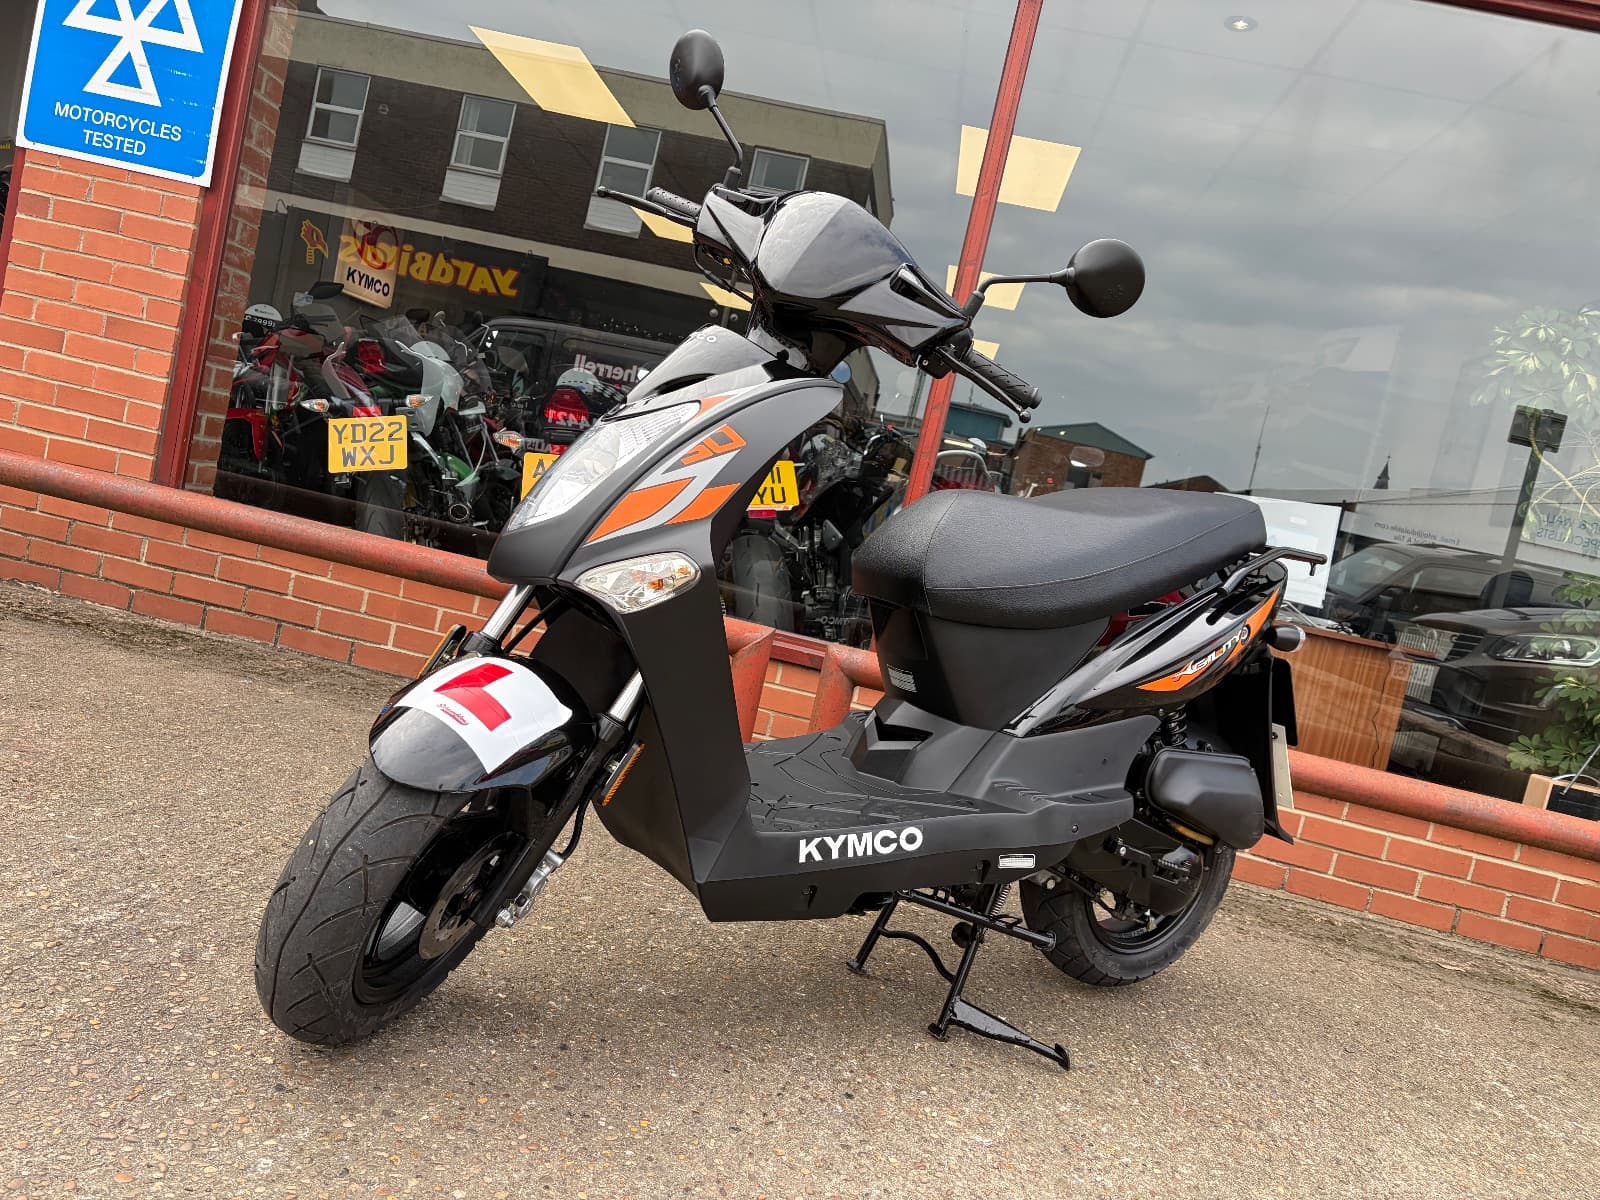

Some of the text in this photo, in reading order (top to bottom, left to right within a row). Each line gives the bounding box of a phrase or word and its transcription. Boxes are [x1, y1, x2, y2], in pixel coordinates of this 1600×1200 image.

[54, 101, 182, 142] MOTORCYCLES
[83, 129, 146, 156] TESTED
[346, 266, 390, 297] KYMCO
[332, 421, 404, 445] YD22
[341, 444, 395, 468] WXJ
[799, 826, 924, 863] KYMCO
